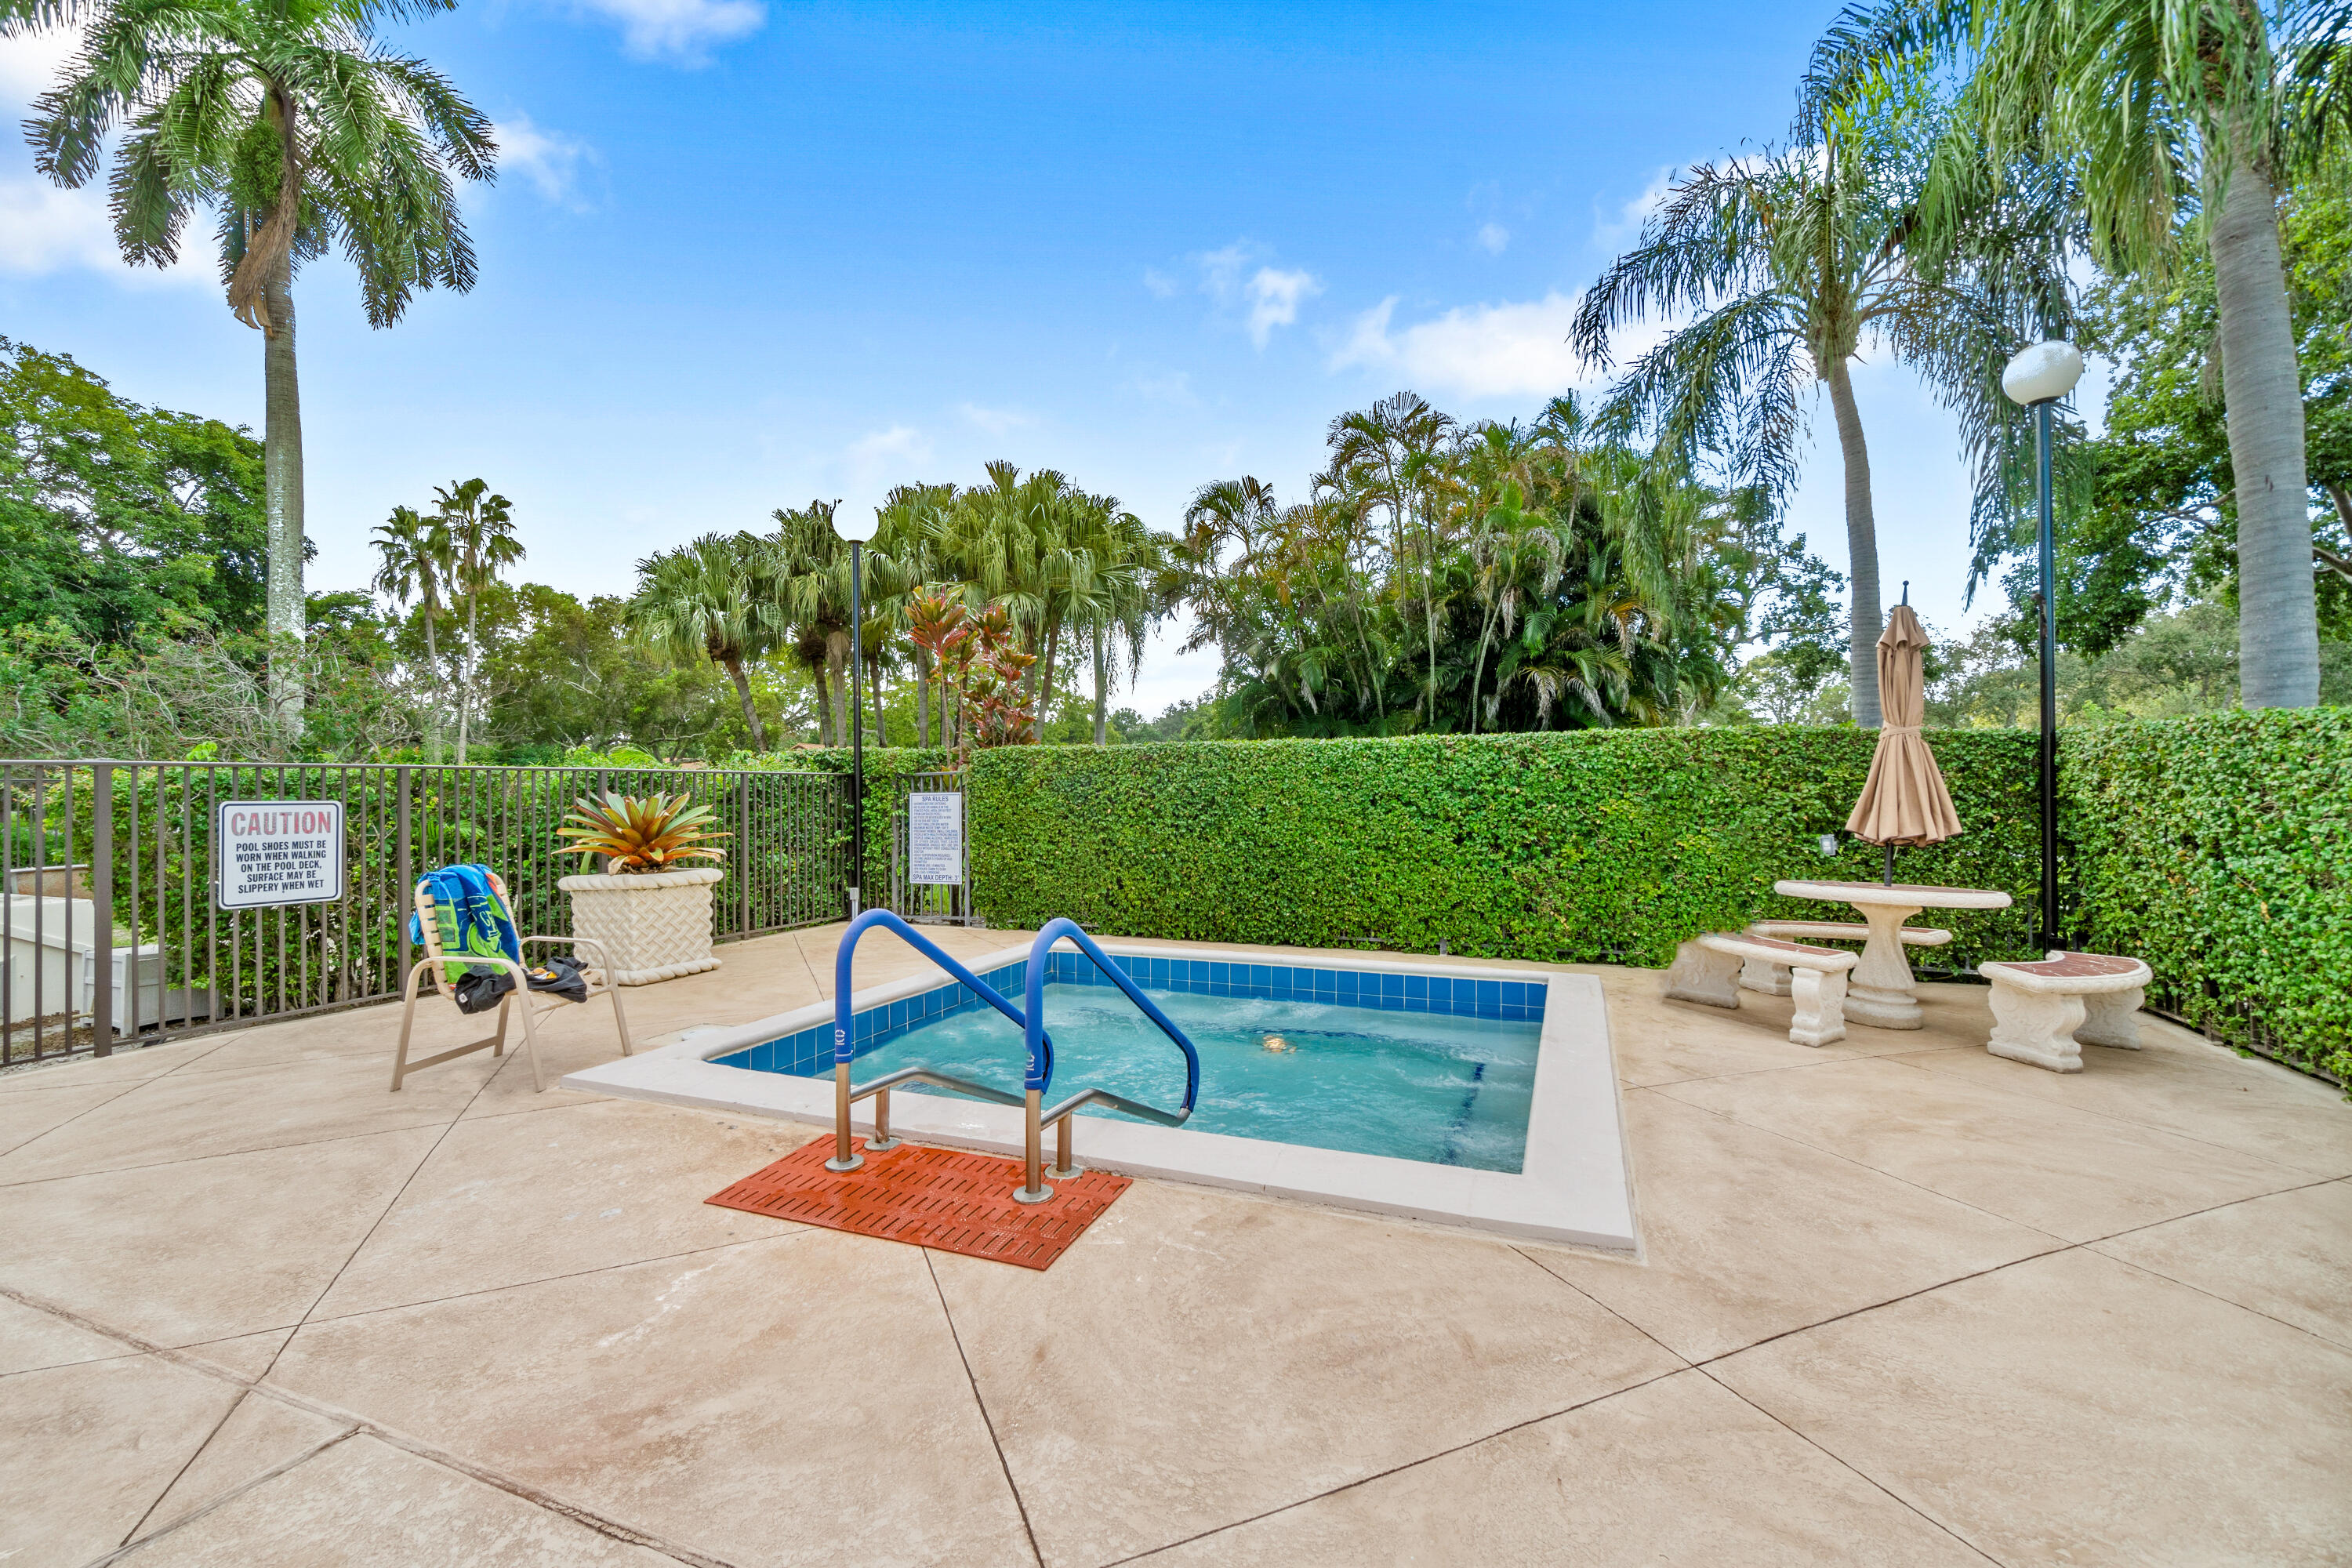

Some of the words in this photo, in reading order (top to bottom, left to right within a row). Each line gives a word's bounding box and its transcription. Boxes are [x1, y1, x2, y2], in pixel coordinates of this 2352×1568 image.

[231, 811, 332, 836] CAUTION
[236, 843, 259, 851] POOL
[262, 842, 289, 851] SHOES
[236, 853, 261, 862] WORN
[265, 852, 288, 861] WHEN
[292, 851, 326, 859] WALKING
[241, 863, 252, 872] ON
[274, 862, 296, 870] POOL
[299, 860, 322, 870] DECK,
[247, 872, 283, 882] SURFACE
[286, 871, 303, 880] MAY
[238, 883, 278, 894] SLIPPERY
[282, 881, 304, 890] WHEN
[308, 880, 324, 888] WET
